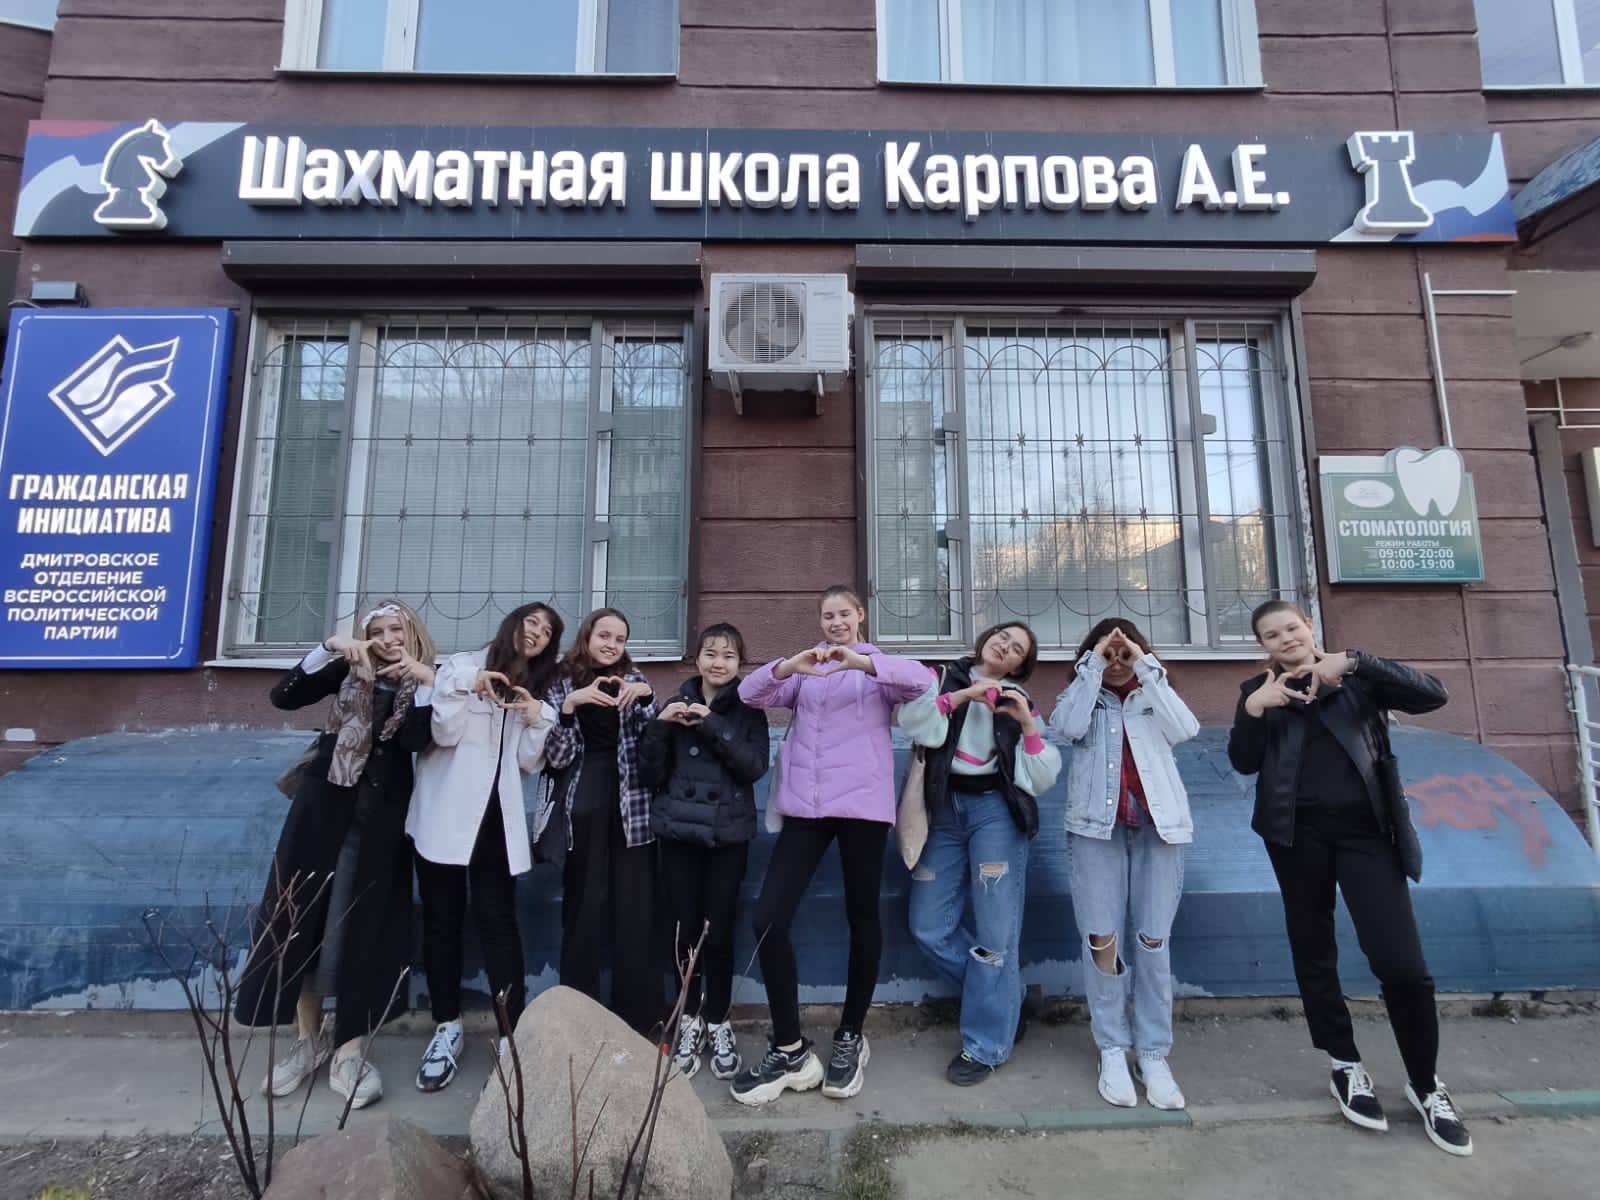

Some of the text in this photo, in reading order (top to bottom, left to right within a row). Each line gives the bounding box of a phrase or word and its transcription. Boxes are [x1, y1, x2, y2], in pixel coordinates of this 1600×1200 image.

[238, 135, 1291, 222] Шахматная школа Карпова А.Е.
[8, 473, 190, 502] ГРАЖДАНСКАЯ
[16, 507, 173, 535] ИНИЦИАТИВА
[1339, 520, 1472, 537] СТОМАТОЛОГИЯ
[20, 552, 161, 569] ДМИТРОВСКОЕ
[1378, 548, 1454, 559] 09:00-20:00
[1380, 559, 1455, 569] 10:00-19:00
[33, 571, 144, 587] ОТДЕЛЕНИЕ
[3, 586, 167, 604] ВСЕРОССИЙСКОЙ
[7, 604, 159, 622] ПОЛИТИЧЕСКОЙ
[43, 625, 118, 641] ПАРТИИ
